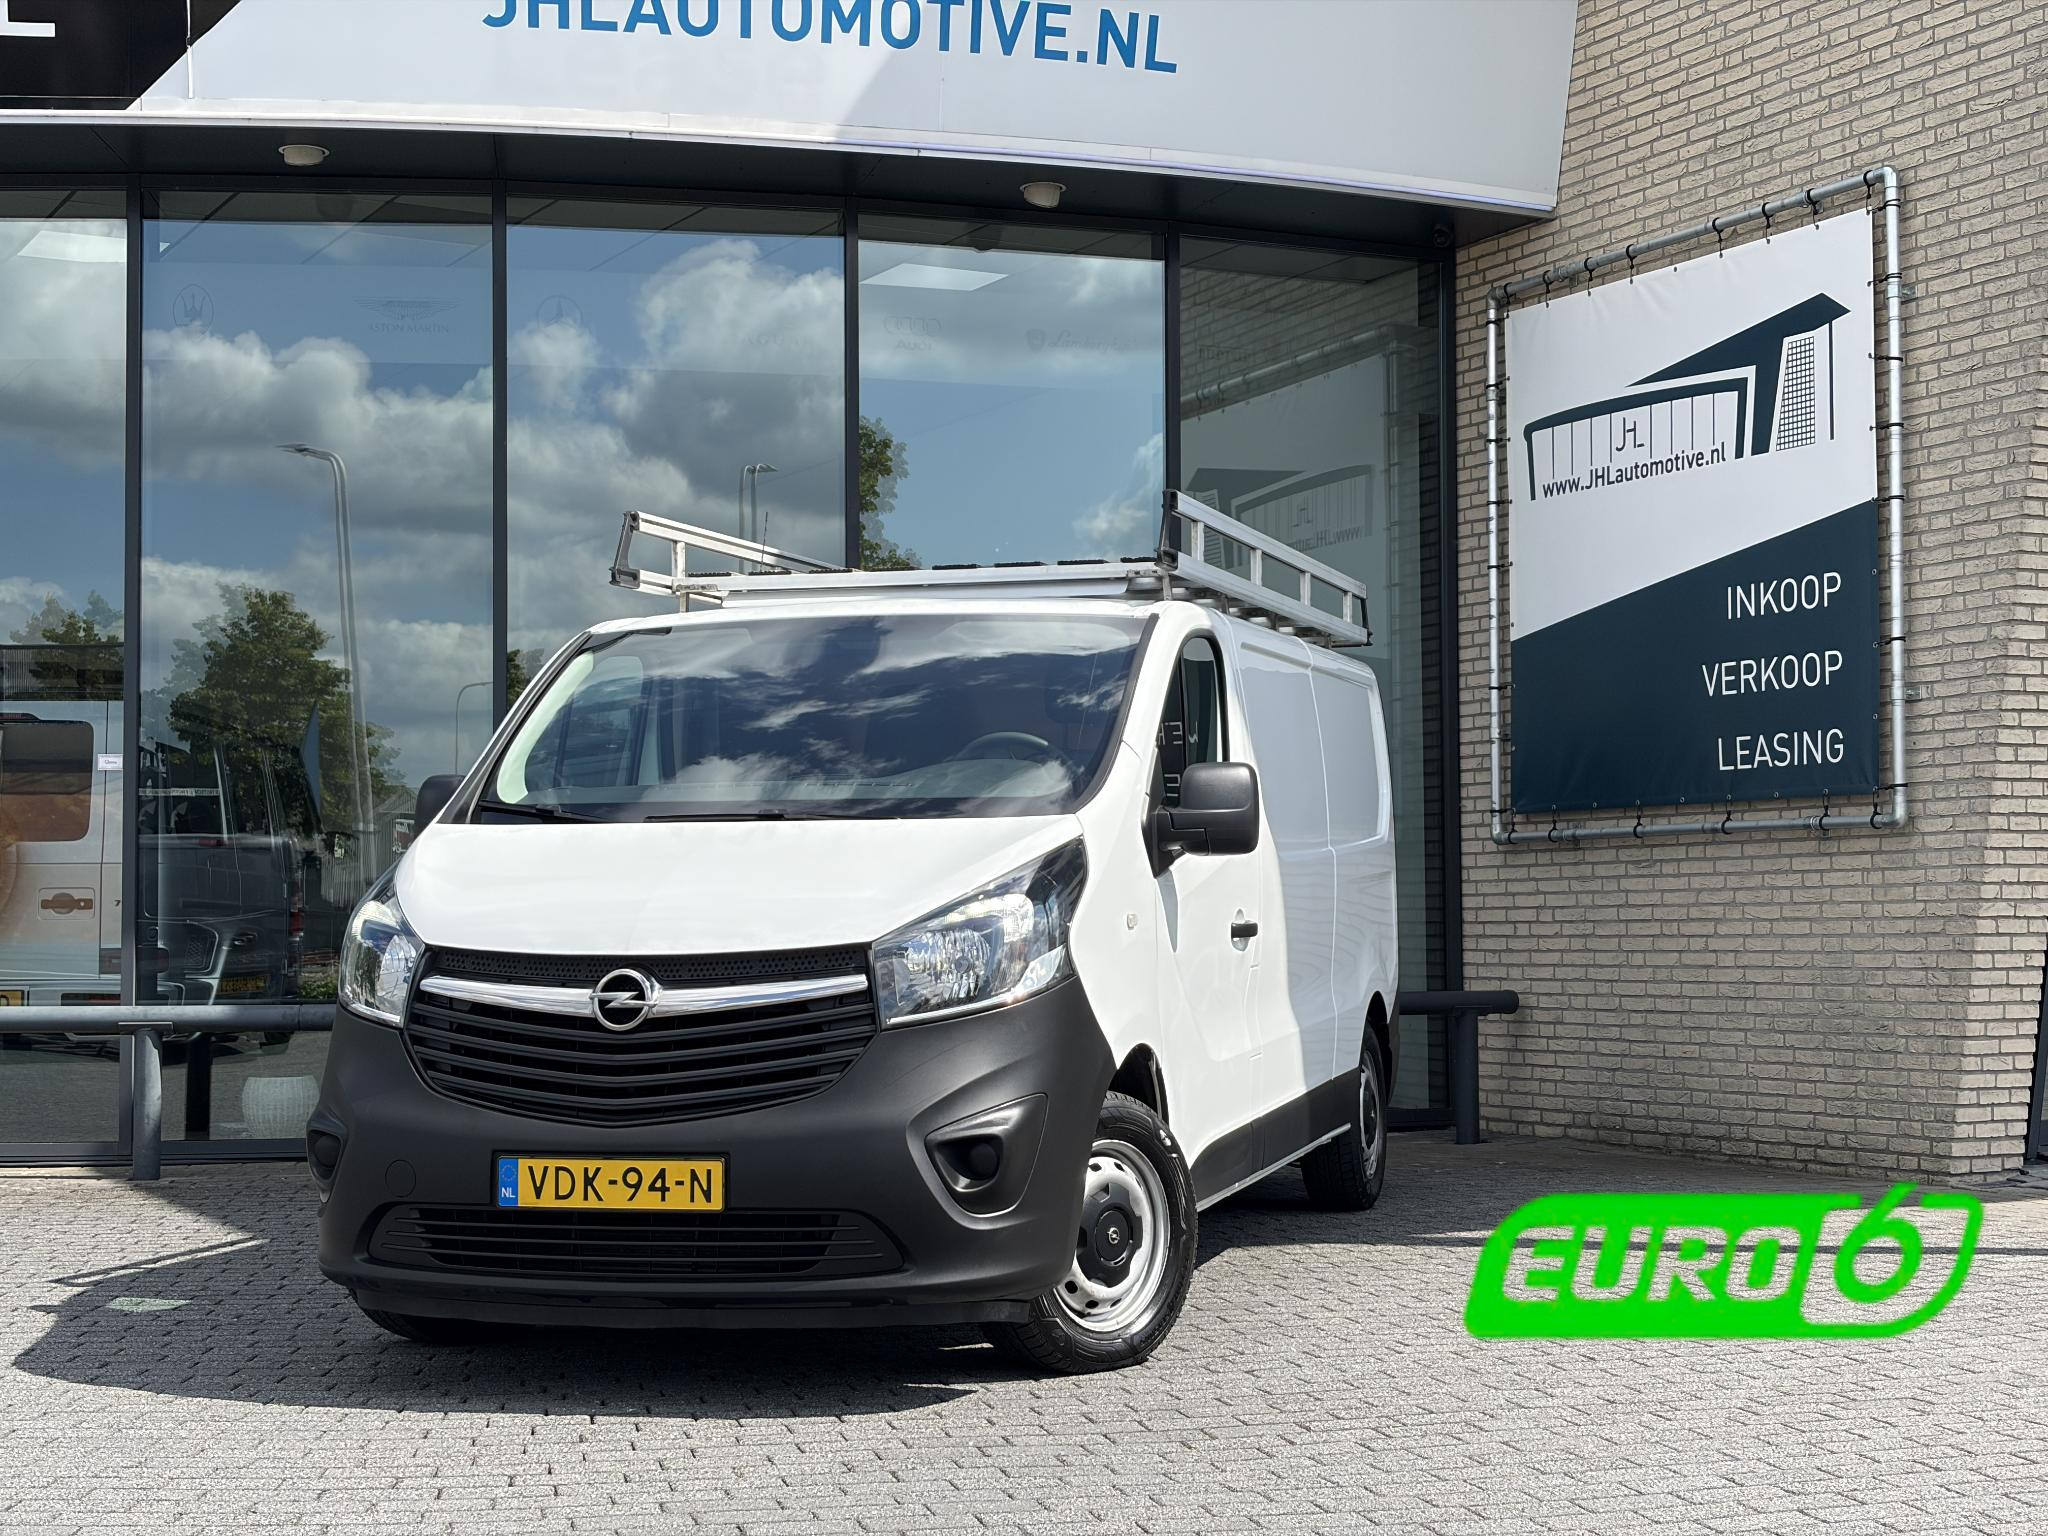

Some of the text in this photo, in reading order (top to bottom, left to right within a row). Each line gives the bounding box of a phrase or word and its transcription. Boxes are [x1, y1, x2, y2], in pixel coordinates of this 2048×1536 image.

[1542, 441, 1726, 499] www.JHLautomotive.nl
[1726, 571, 1842, 620] INKOOP
[1701, 650, 1843, 697] VERKOOP
[1717, 728, 1844, 771] LEASING
[501, 1187, 516, 1199] NL
[527, 1165, 713, 1204] VDK-94-N
